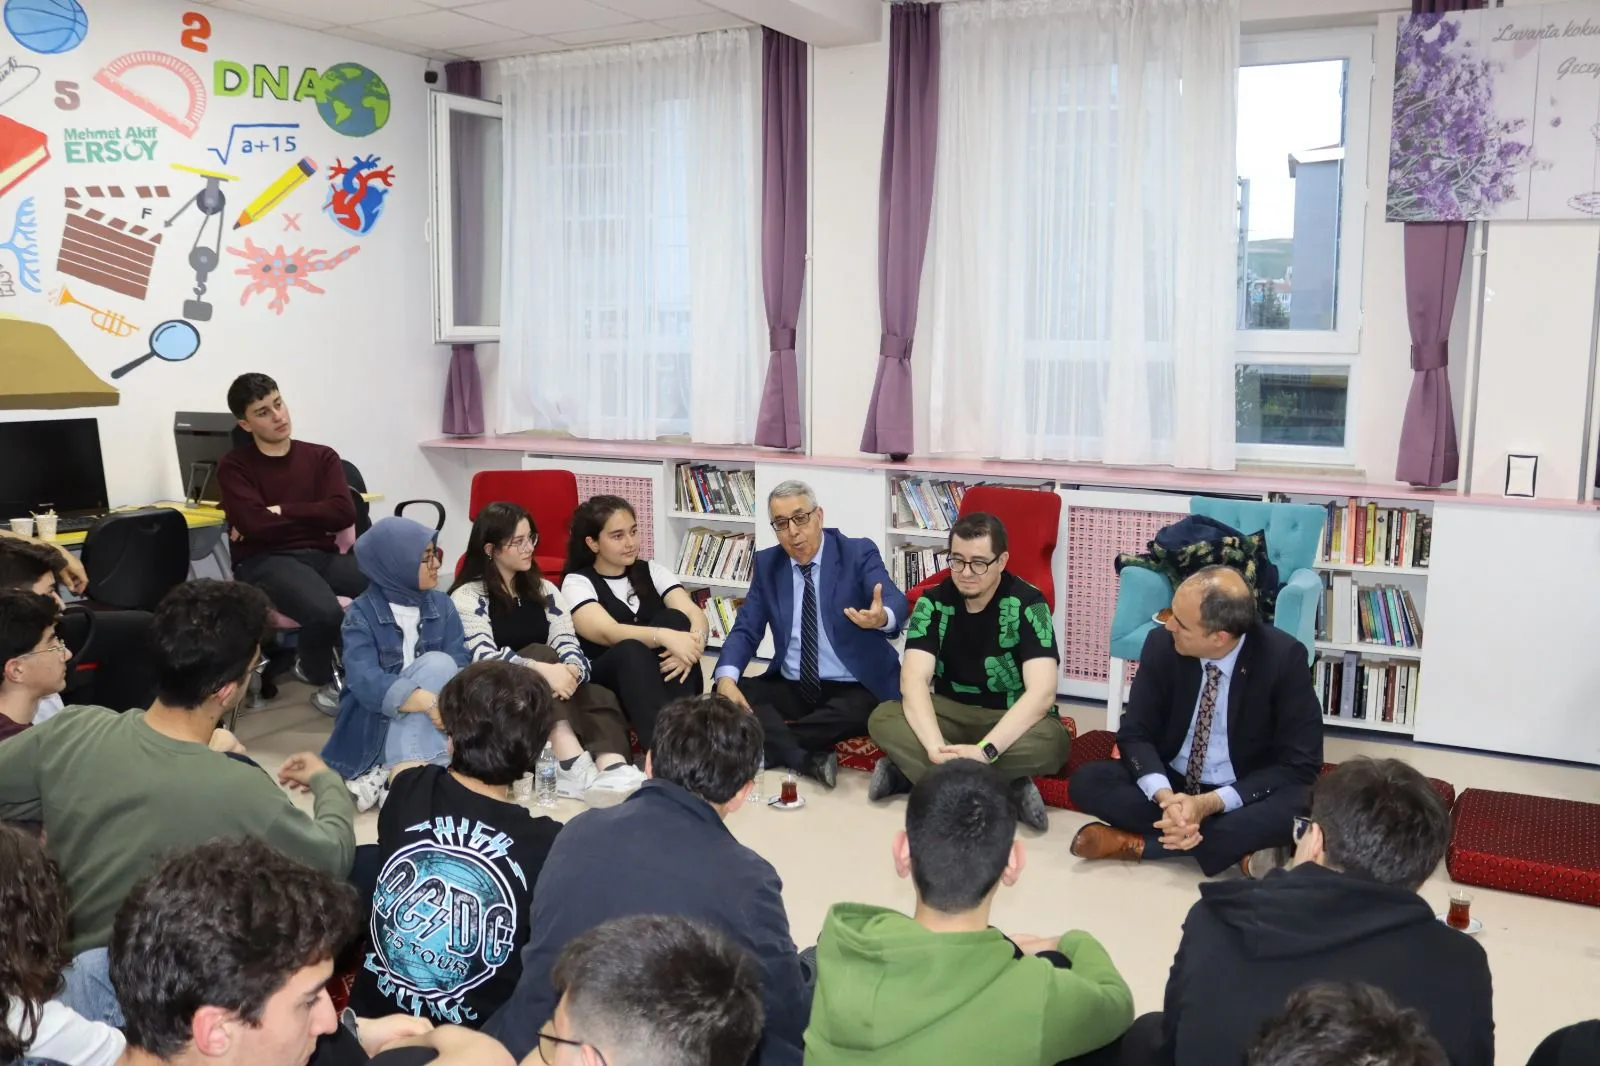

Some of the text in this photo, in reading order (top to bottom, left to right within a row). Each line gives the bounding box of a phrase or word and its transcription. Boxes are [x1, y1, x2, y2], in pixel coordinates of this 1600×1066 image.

[181, 12, 211, 53] 2
[1492, 23, 1560, 42] Lavanta
[54, 80, 81, 112] 5
[213, 60, 328, 104] DNA
[64, 127, 122, 141] Mehmet
[64, 139, 158, 164] ERSOY
[142, 207, 152, 219] F
[410, 942, 469, 977] TOUR
